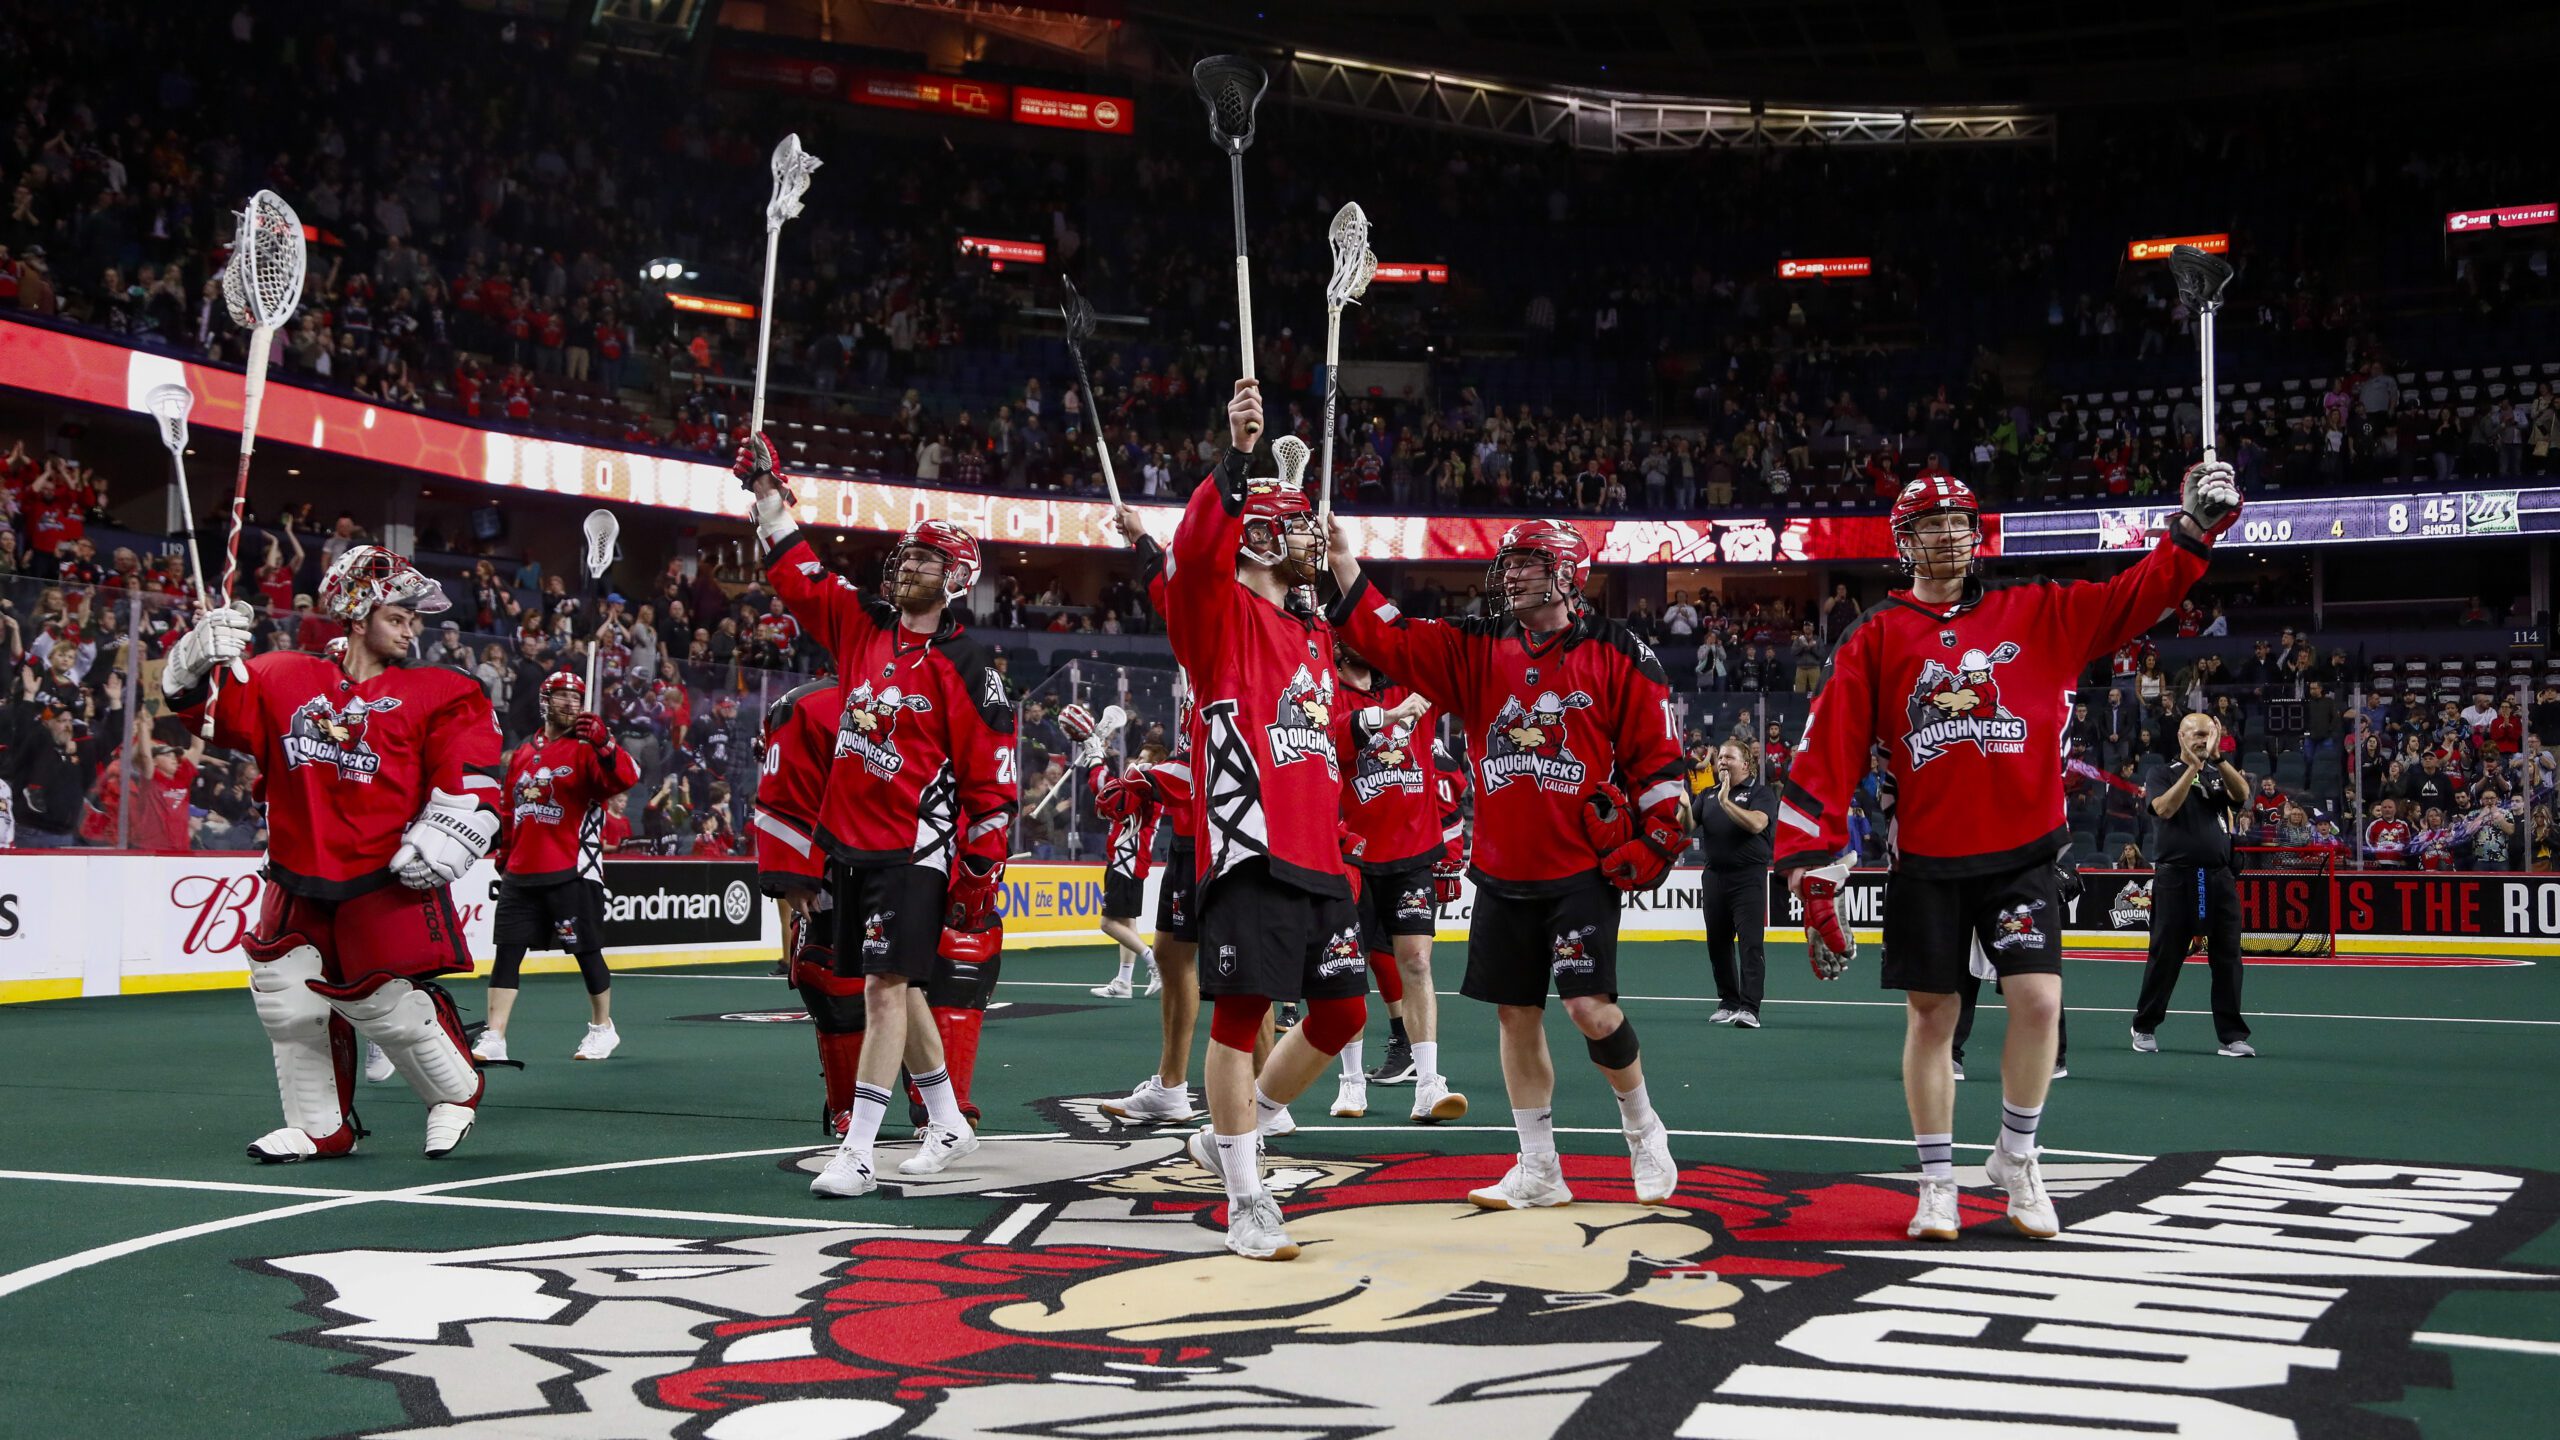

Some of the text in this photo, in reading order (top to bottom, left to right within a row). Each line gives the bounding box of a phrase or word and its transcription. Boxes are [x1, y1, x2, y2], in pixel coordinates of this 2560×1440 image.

[2502, 212, 2529, 221] LIVES
[2531, 210, 2556, 218] HERE
[1825, 263, 1847, 271] LIVES
[1848, 262, 1869, 270] HERE
[2388, 503, 2409, 534] 8
[2423, 499, 2457, 523] 45
[2244, 520, 2292, 542] 00.0
[2331, 519, 2345, 538] 4
[2422, 523, 2461, 536] SHOTS
[2513, 630, 2540, 643] 114
[835, 729, 900, 770] ROUGHNECKS
[1908, 715, 2025, 768] ROUGHNECKS
[1987, 742, 2024, 754] CALGARY
[283, 735, 377, 773] ROUGHNECKS
[1482, 751, 1582, 792] ROUGHNECKS
[1544, 779, 1580, 795] CALGARY
[1035, 889, 1053, 908] the
[2236, 880, 2309, 930] HIS
[2394, 881, 2481, 933] THE
[1220, 947, 1234, 956] NLL
